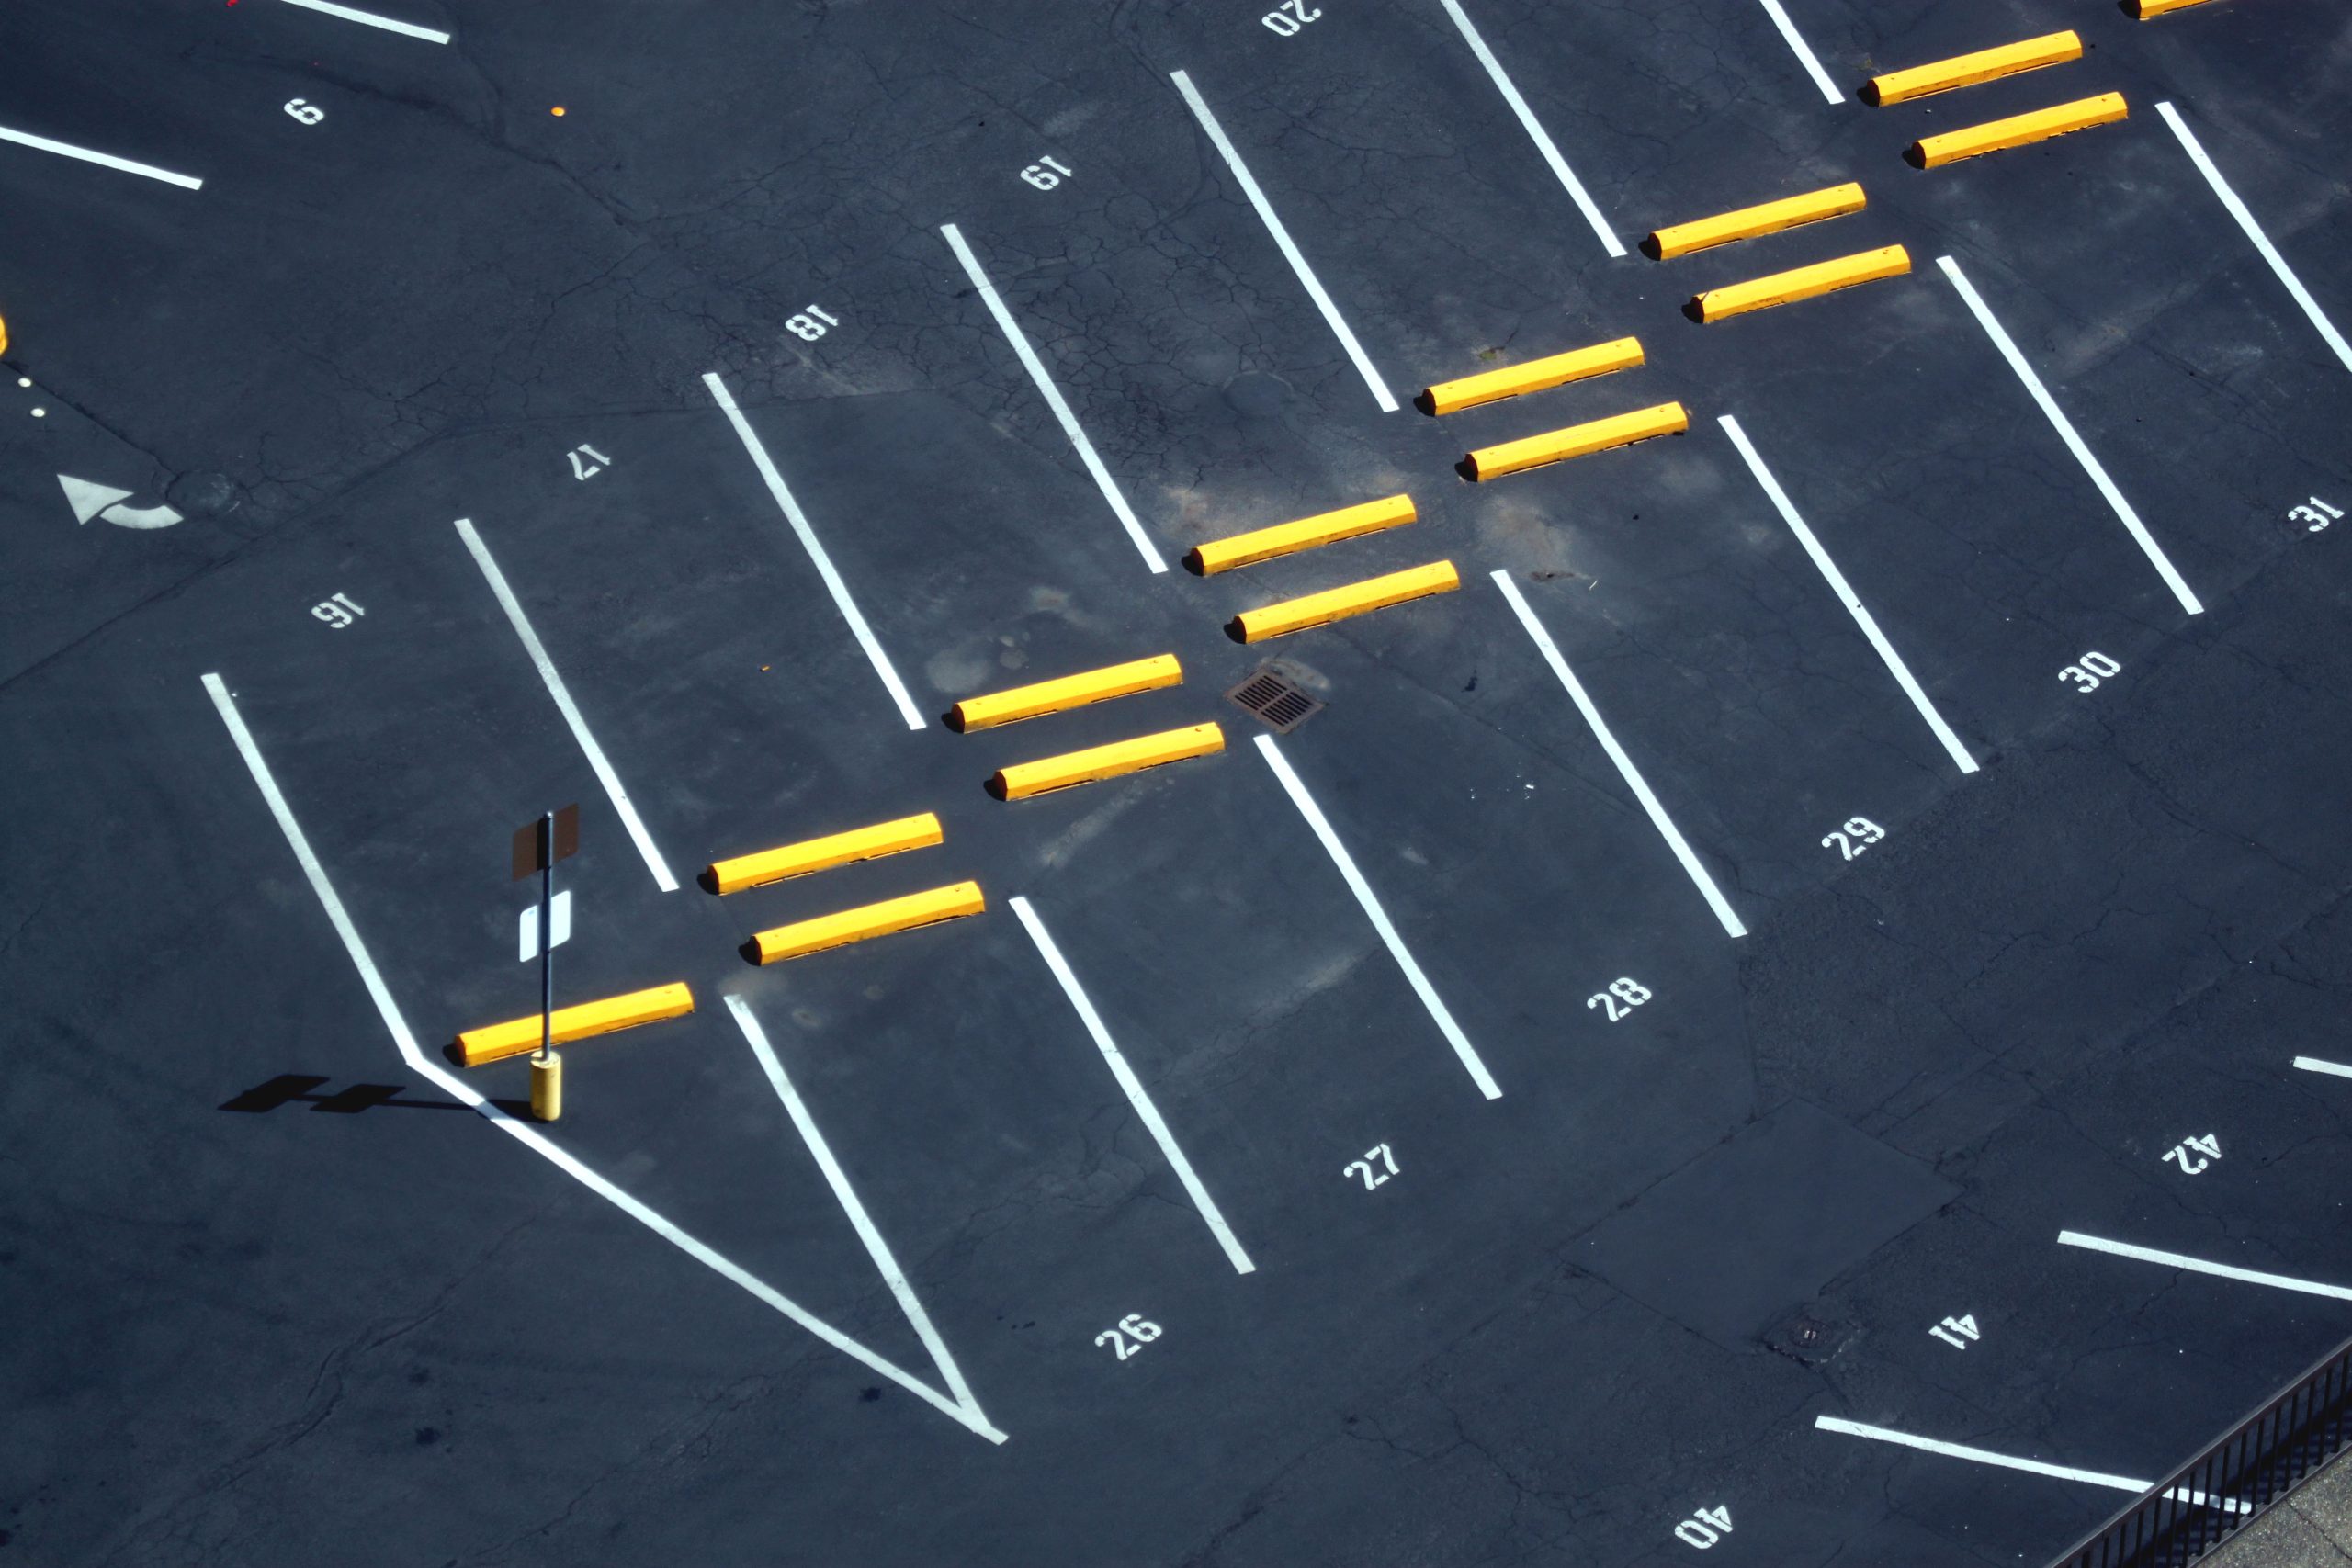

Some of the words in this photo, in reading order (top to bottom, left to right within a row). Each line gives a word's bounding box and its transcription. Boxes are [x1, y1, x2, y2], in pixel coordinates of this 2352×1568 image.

[1261, 0, 1322, 36] 20
[1020, 154, 1072, 190] 19
[785, 304, 839, 341] 18
[566, 443, 611, 481] 17
[2288, 497, 2346, 532] 31
[311, 592, 365, 629] 16
[2058, 651, 2120, 693] 30
[1822, 817, 1885, 862] 29
[1587, 977, 1652, 1021] 28
[1342, 1143, 1400, 1191] 27
[2161, 1134, 2222, 1174] 42
[1095, 1314, 1162, 1360] 26
[1928, 1314, 1981, 1349] 41
[1675, 1506, 1734, 1550] 40
